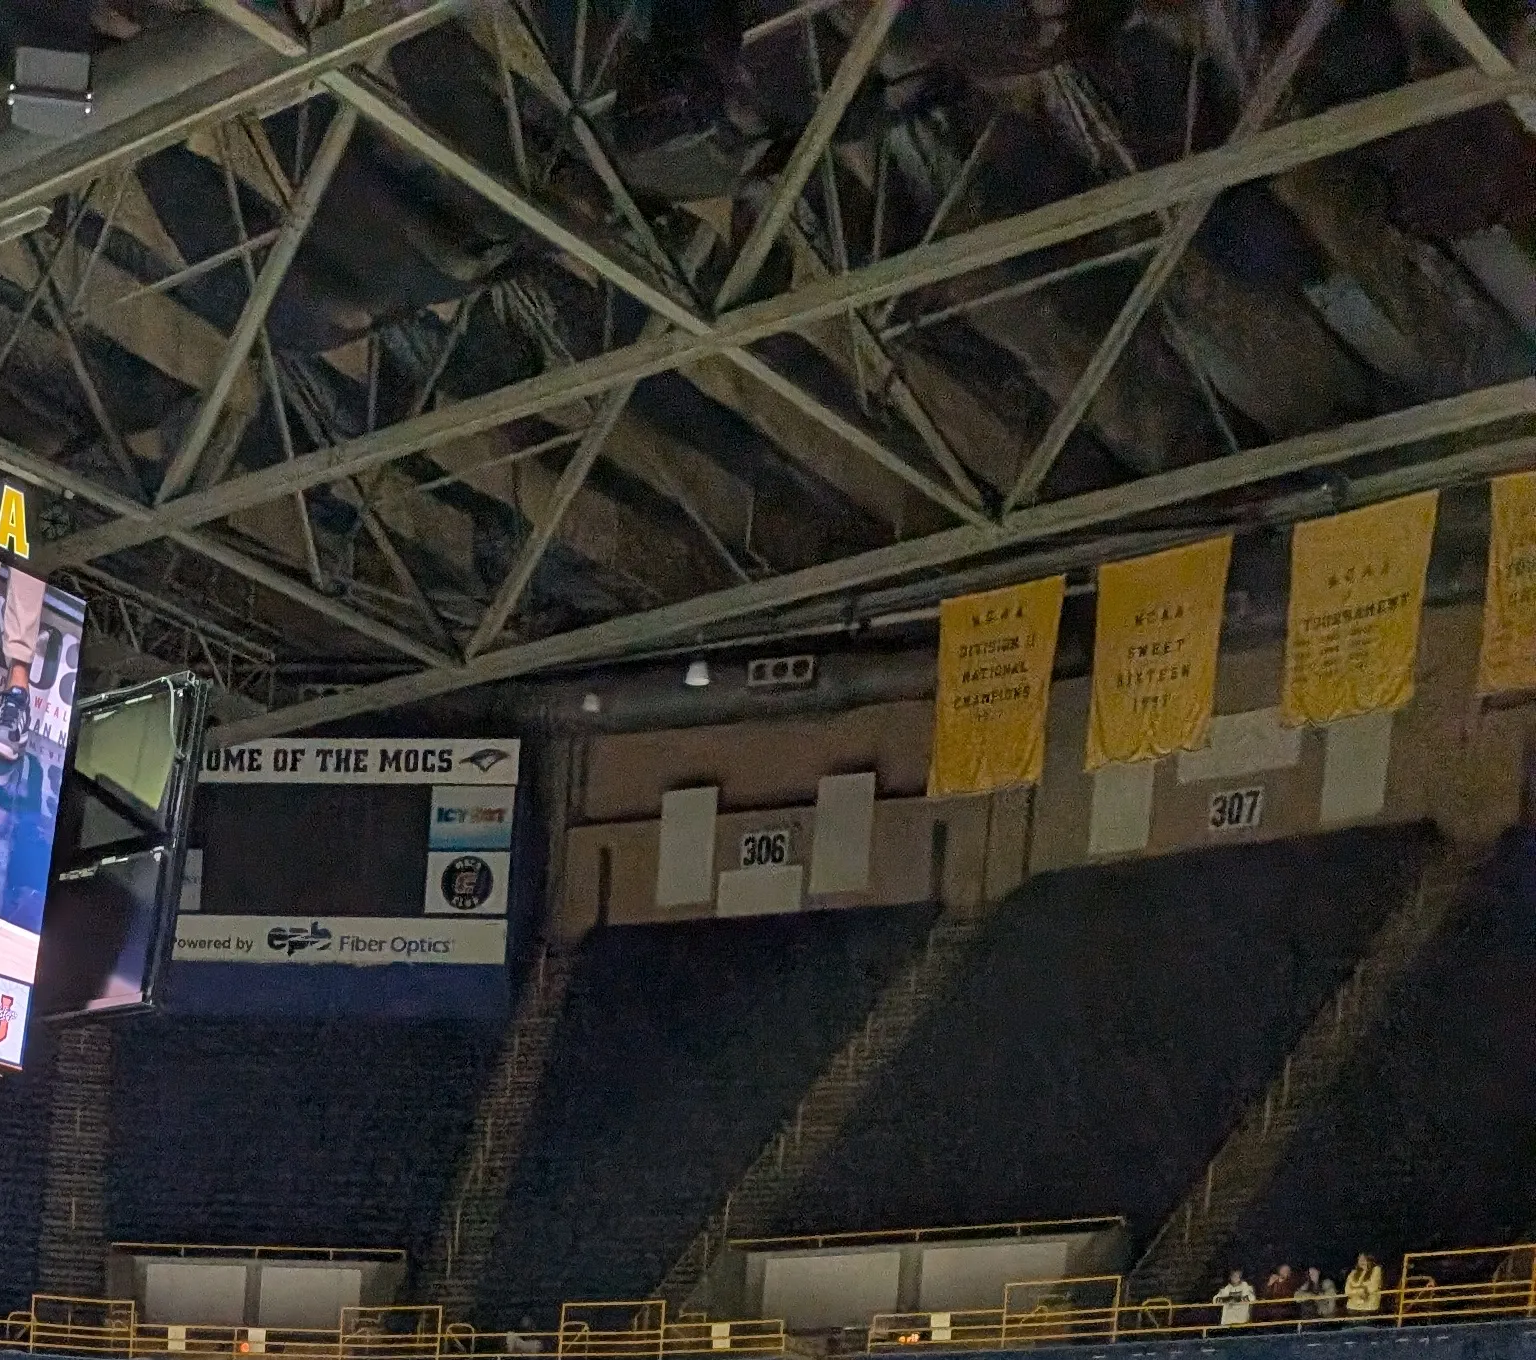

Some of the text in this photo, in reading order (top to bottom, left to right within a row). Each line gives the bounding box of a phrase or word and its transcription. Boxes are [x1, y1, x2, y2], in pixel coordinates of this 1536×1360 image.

[962, 661, 1028, 683] NATIONAL
[274, 748, 453, 773] OF THE MOCS
[1211, 791, 1260, 828] 307
[742, 834, 787, 865] 306
[236, 937, 253, 953] by
[340, 936, 387, 953] Fiber
[390, 936, 450, 956] Optics
